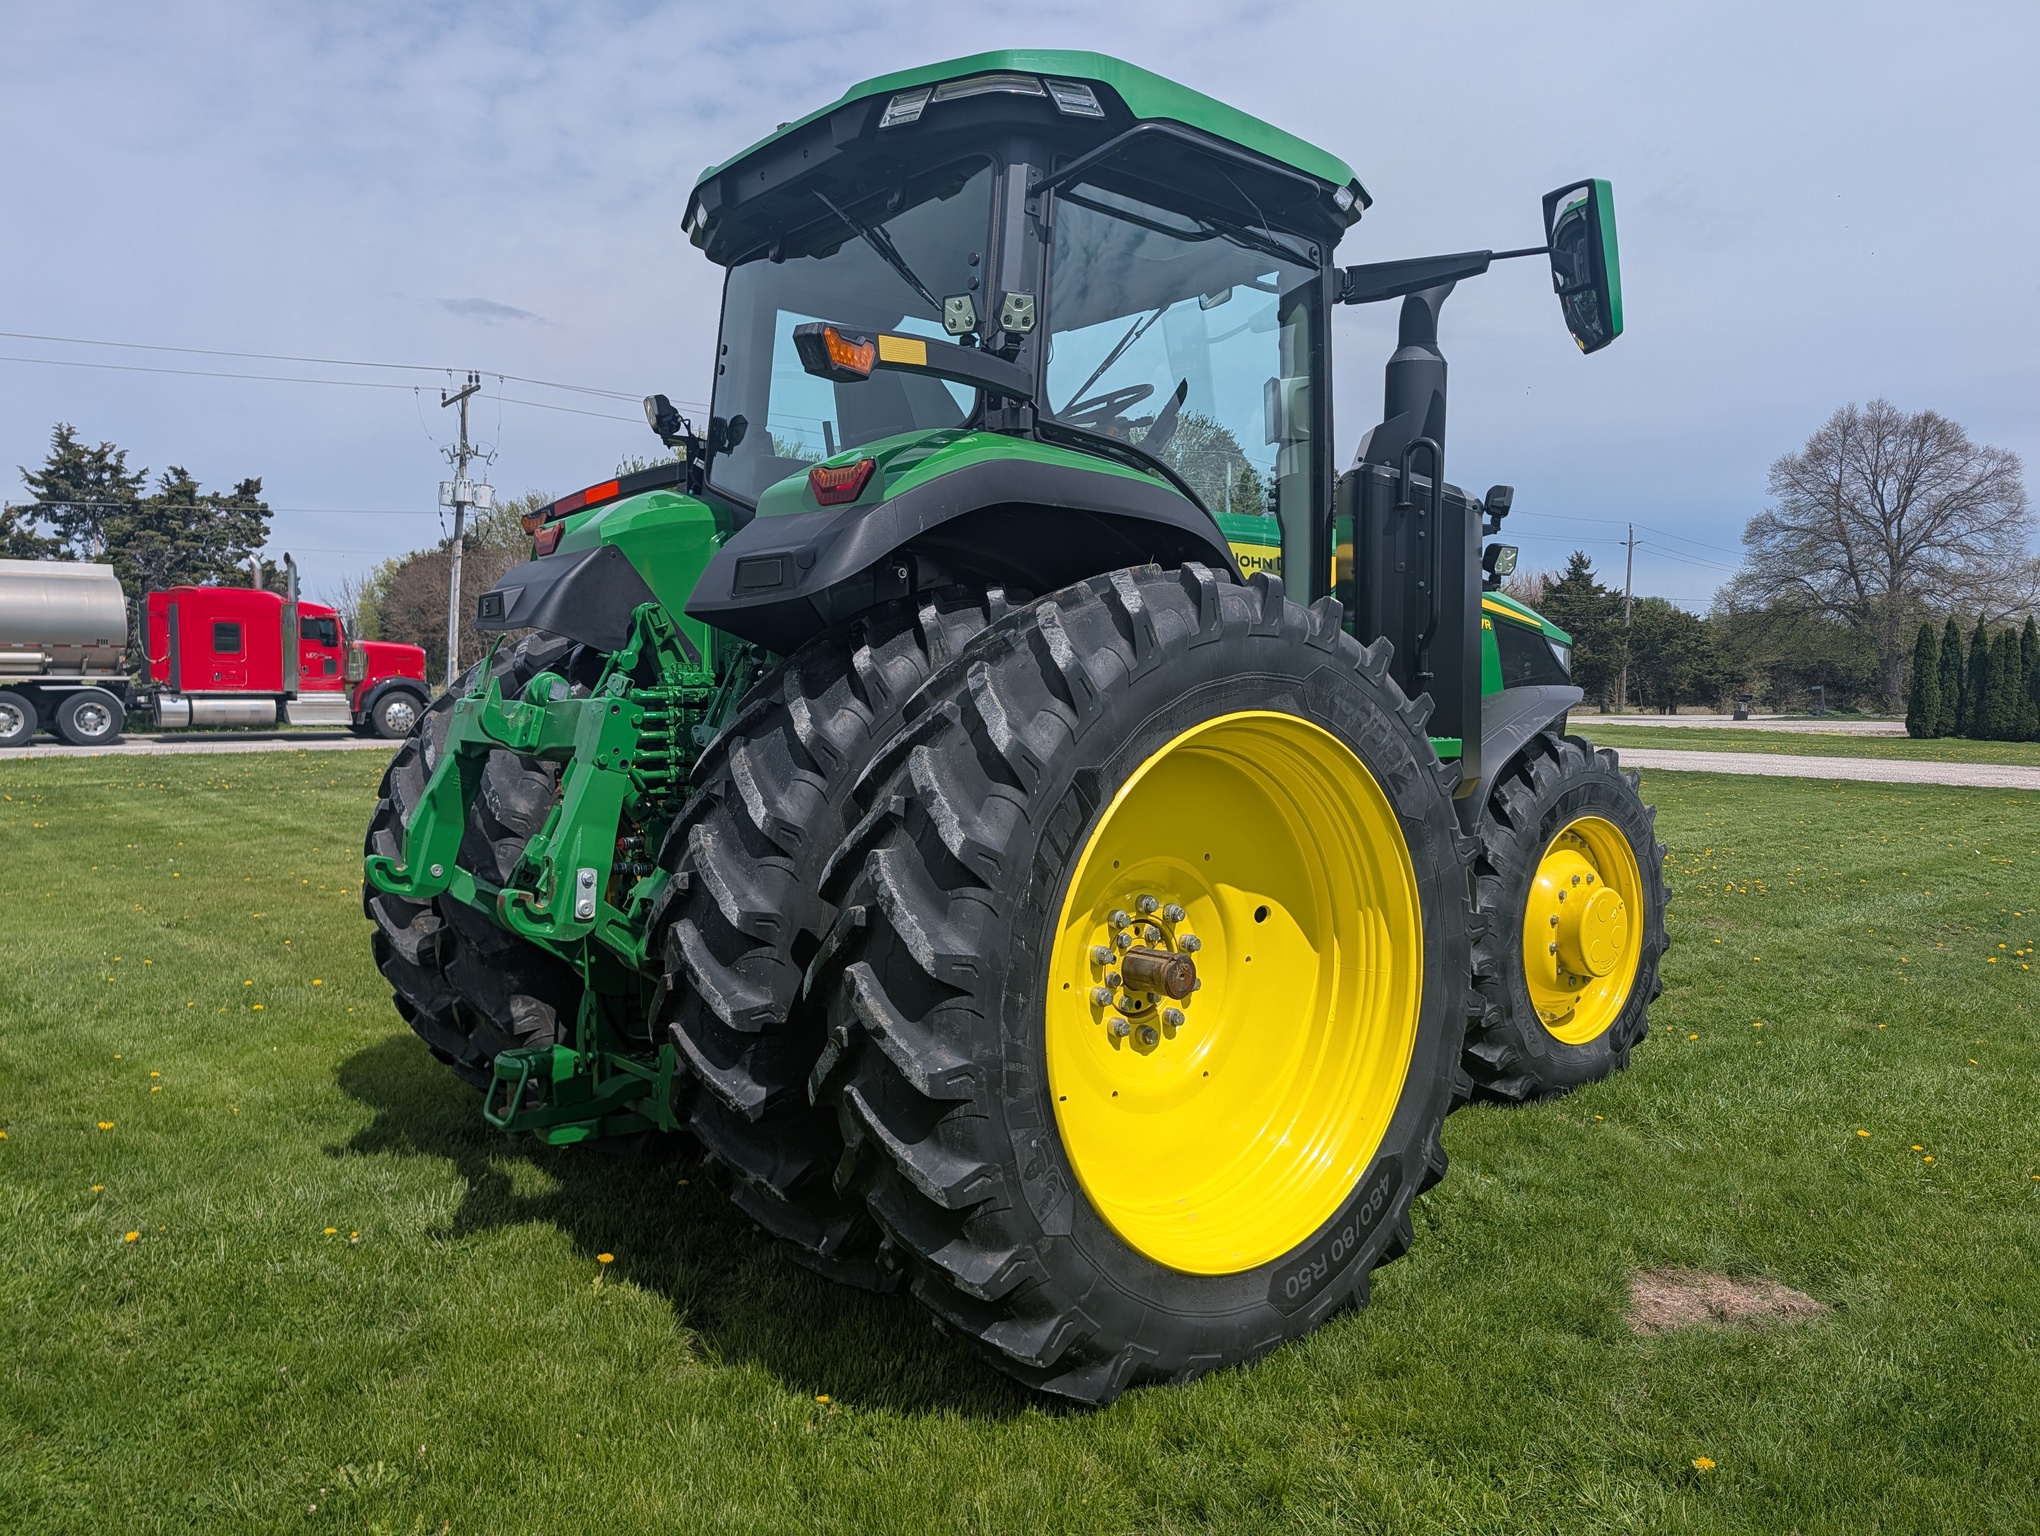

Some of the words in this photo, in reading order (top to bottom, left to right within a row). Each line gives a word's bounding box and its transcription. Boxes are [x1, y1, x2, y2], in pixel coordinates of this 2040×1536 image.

[1002, 787, 1084, 1130] MICHELIN
[1624, 960, 1653, 1029] AGRIBIB
[1614, 1017, 1629, 1045] 2
[1331, 1173, 1390, 1262] 480/80
[1286, 1256, 1328, 1299] R50
